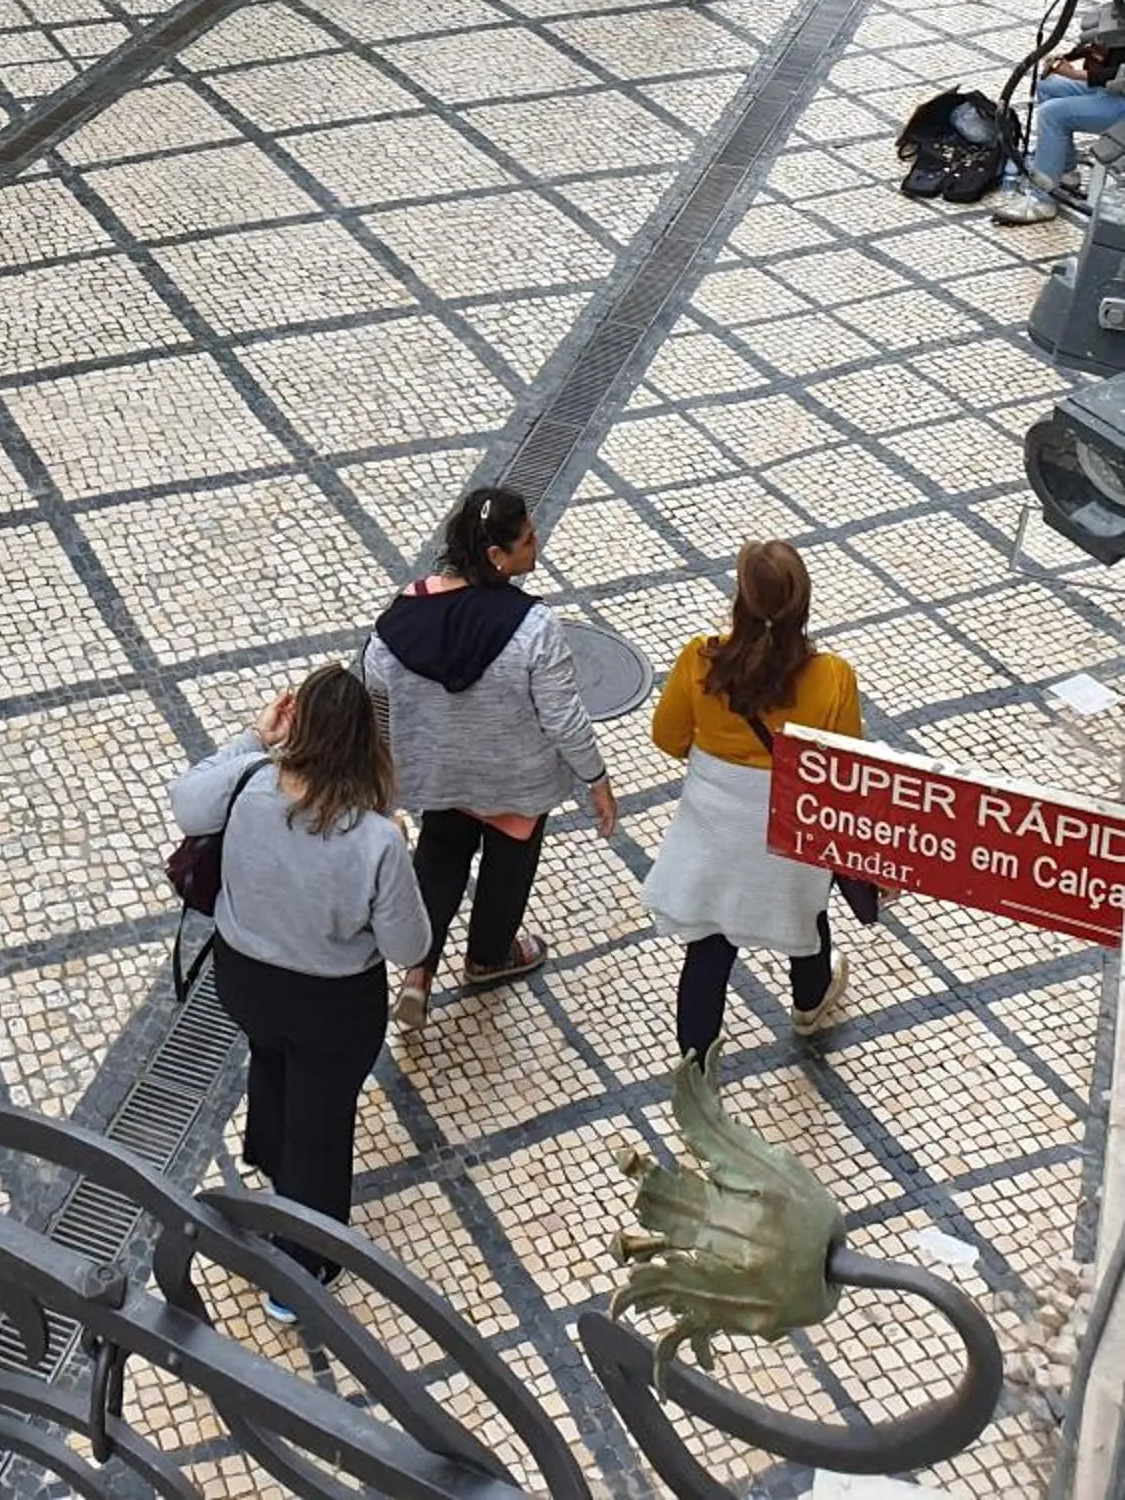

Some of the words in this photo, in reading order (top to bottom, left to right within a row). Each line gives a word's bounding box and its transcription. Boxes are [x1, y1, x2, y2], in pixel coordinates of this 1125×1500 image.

[797, 750, 956, 819] SUPER
[796, 794, 956, 862] Consertos
[971, 846, 1018, 879] em
[1032, 854, 1125, 910] Calça
